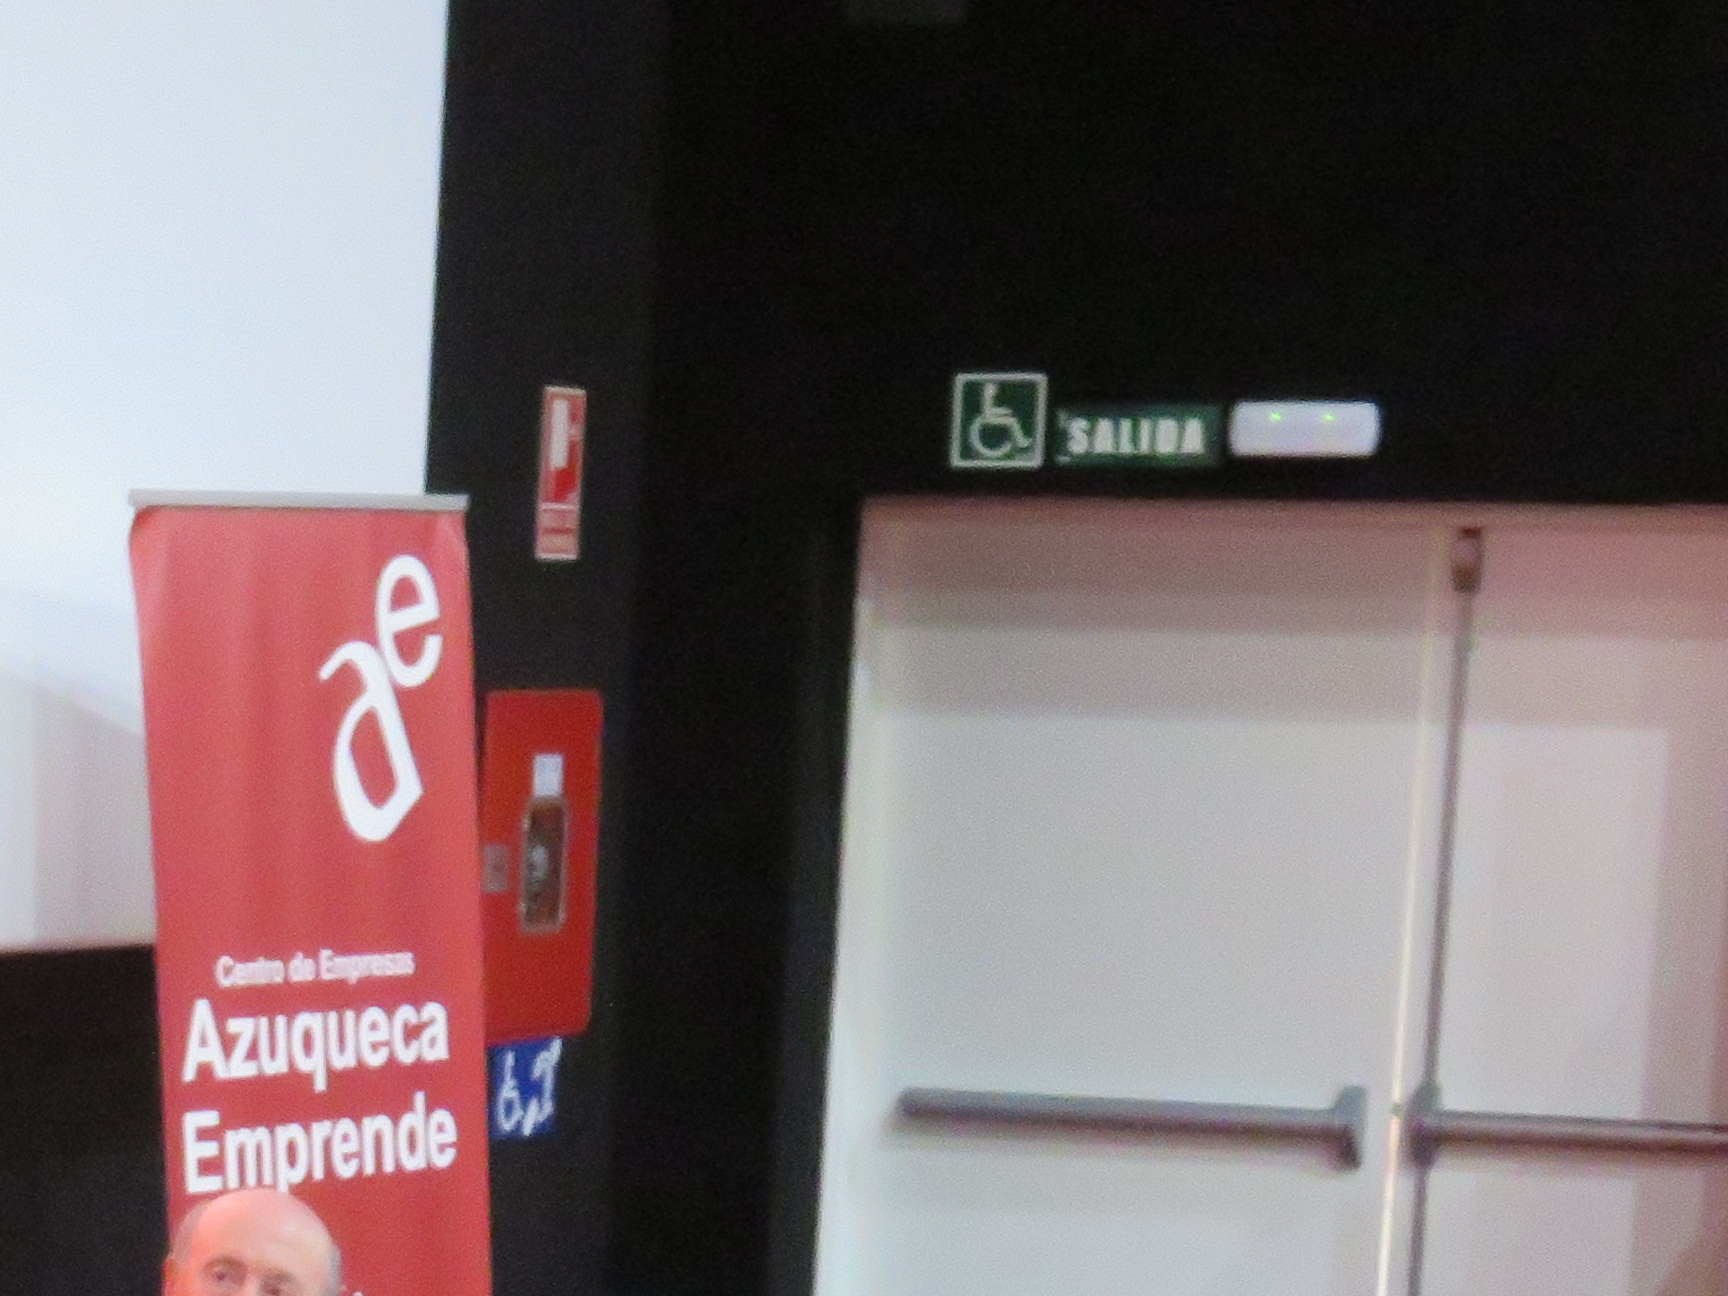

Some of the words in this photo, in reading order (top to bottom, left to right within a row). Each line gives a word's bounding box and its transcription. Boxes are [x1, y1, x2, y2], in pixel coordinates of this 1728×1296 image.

[1067, 417, 1206, 454] SALIDA
[215, 955, 285, 988] Centro
[288, 951, 316, 983] de
[319, 948, 416, 984] Empresas
[181, 997, 450, 1093] Azuqueca
[181, 1090, 458, 1194] Emprende
